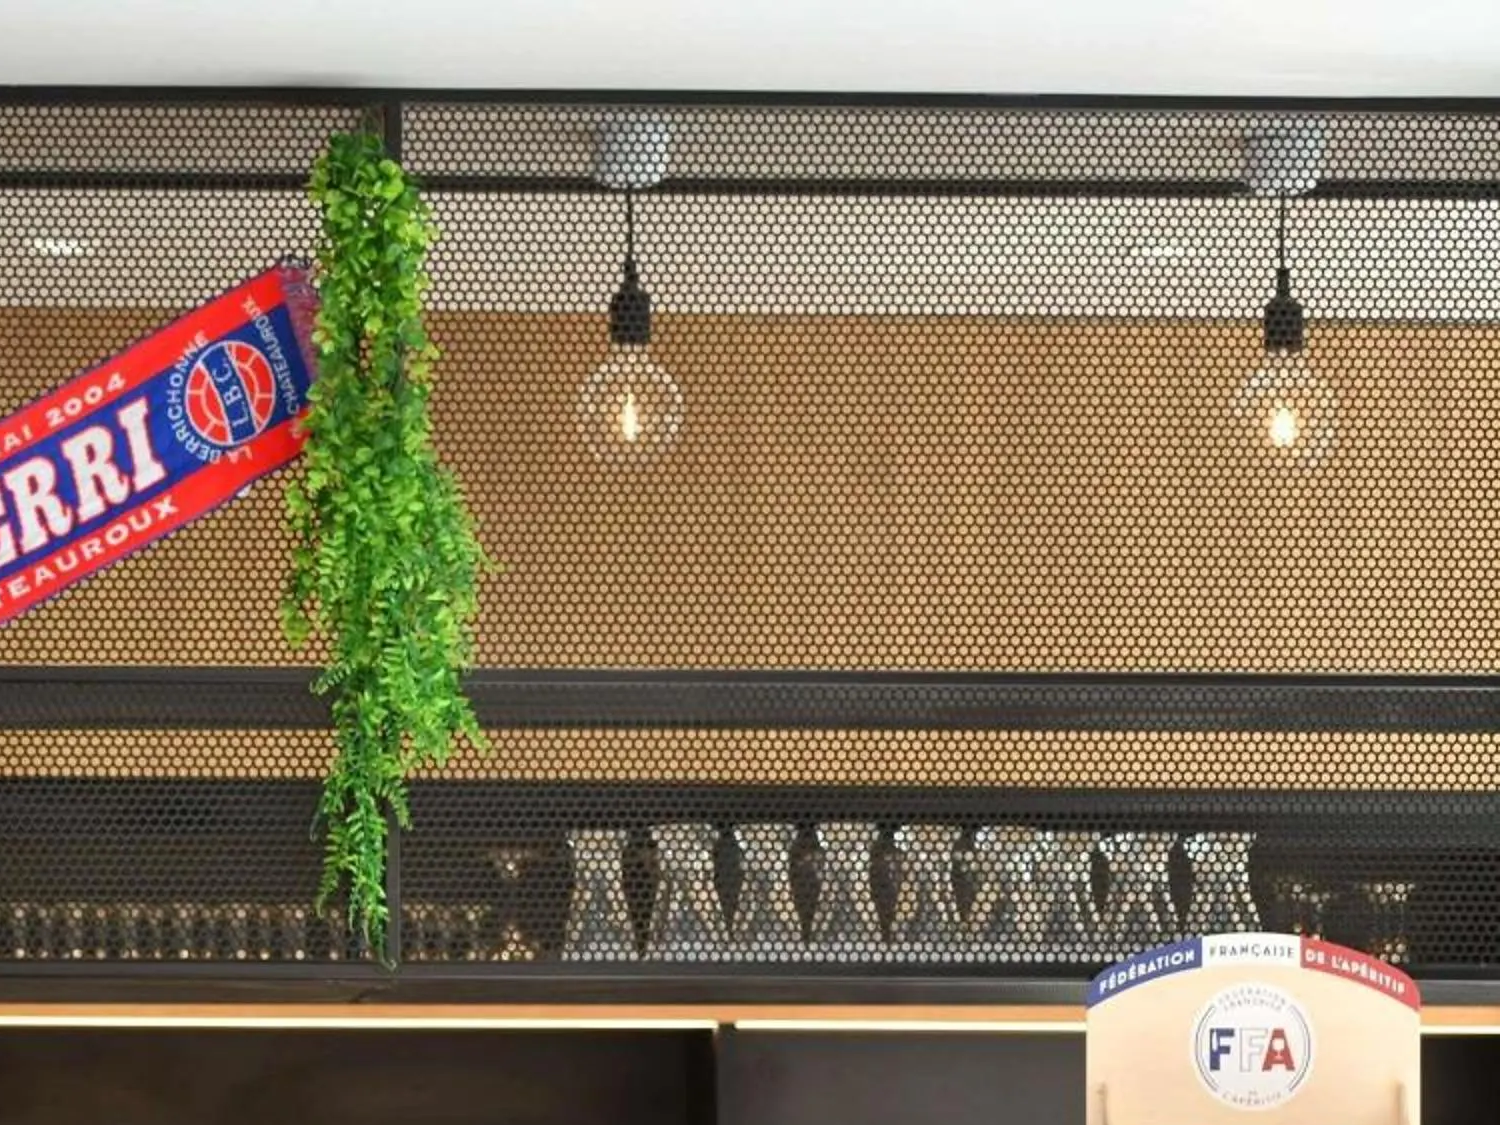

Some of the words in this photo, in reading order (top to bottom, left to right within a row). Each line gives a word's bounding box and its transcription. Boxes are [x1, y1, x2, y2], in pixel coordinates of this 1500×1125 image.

[45, 372, 127, 425] 2004
[1099, 948, 1195, 995] FÉDÉRATION
[1208, 943, 1295, 959] FRANÇAISE
[1304, 948, 1326, 965] DE
[1209, 1027, 1296, 1072] FFA
